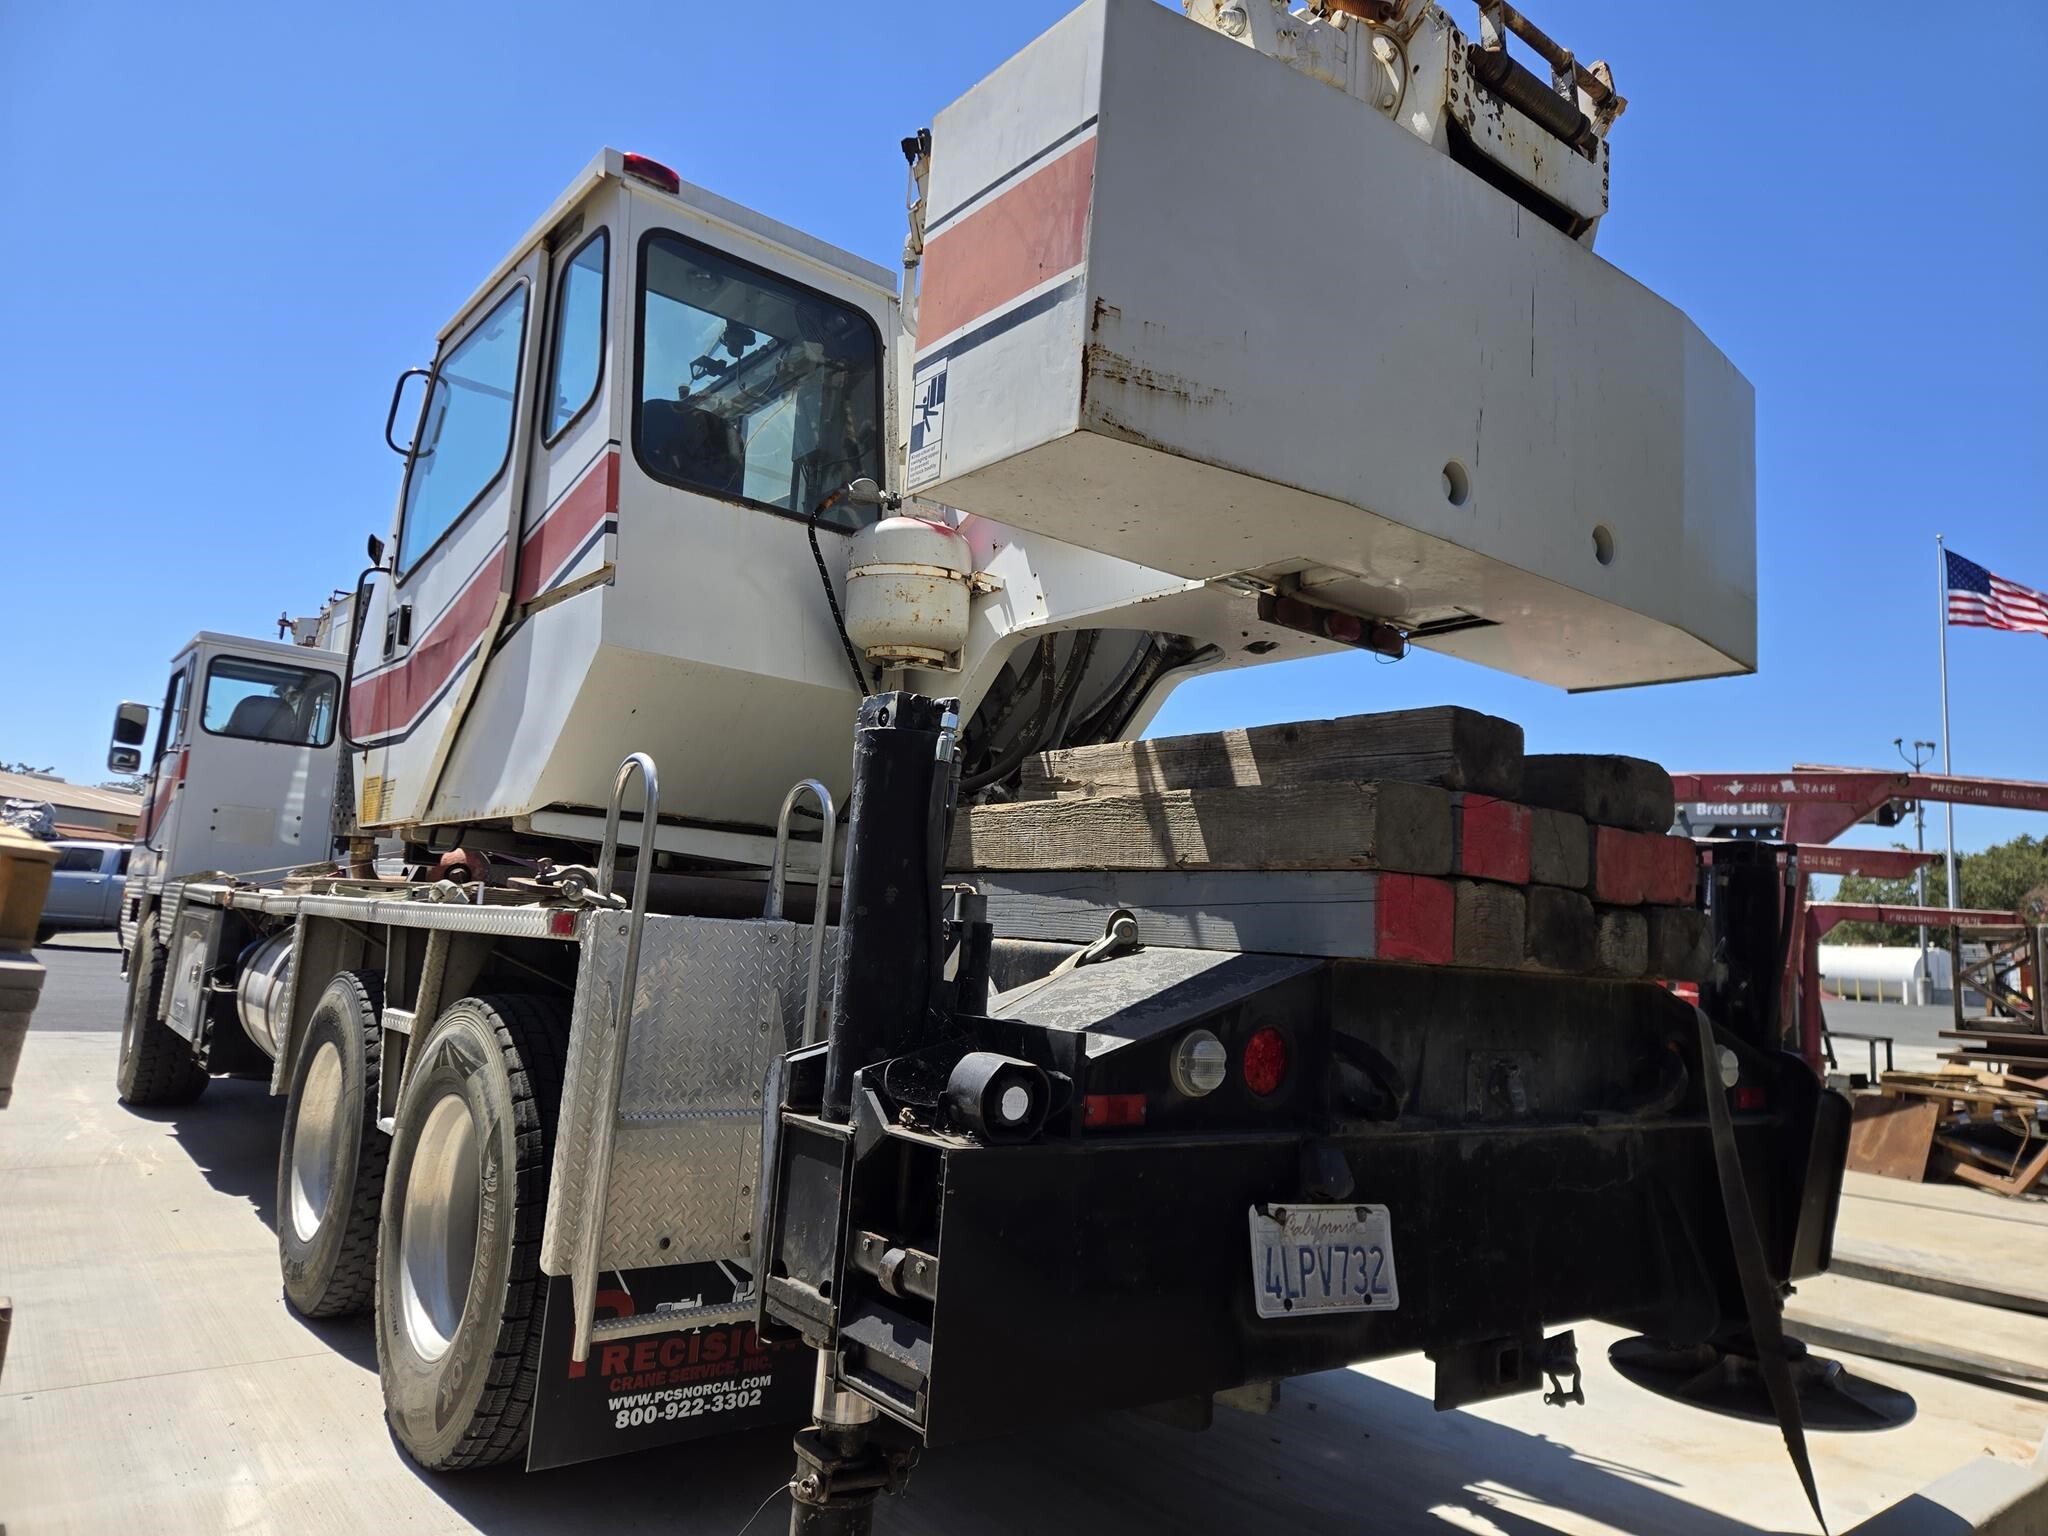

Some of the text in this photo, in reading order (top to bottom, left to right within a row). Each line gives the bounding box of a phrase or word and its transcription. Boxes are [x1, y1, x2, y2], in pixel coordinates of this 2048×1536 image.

[1696, 802, 1769, 815] Brute Lift
[1281, 1213, 1360, 1243] California
[1264, 1244, 1389, 1300] 4LPV732
[608, 1374, 773, 1411] WWW.PCSNORCAL.COM
[609, 1355, 773, 1393] CRANE SERVICE, INC.
[614, 1388, 763, 1430] 800-922-3302
